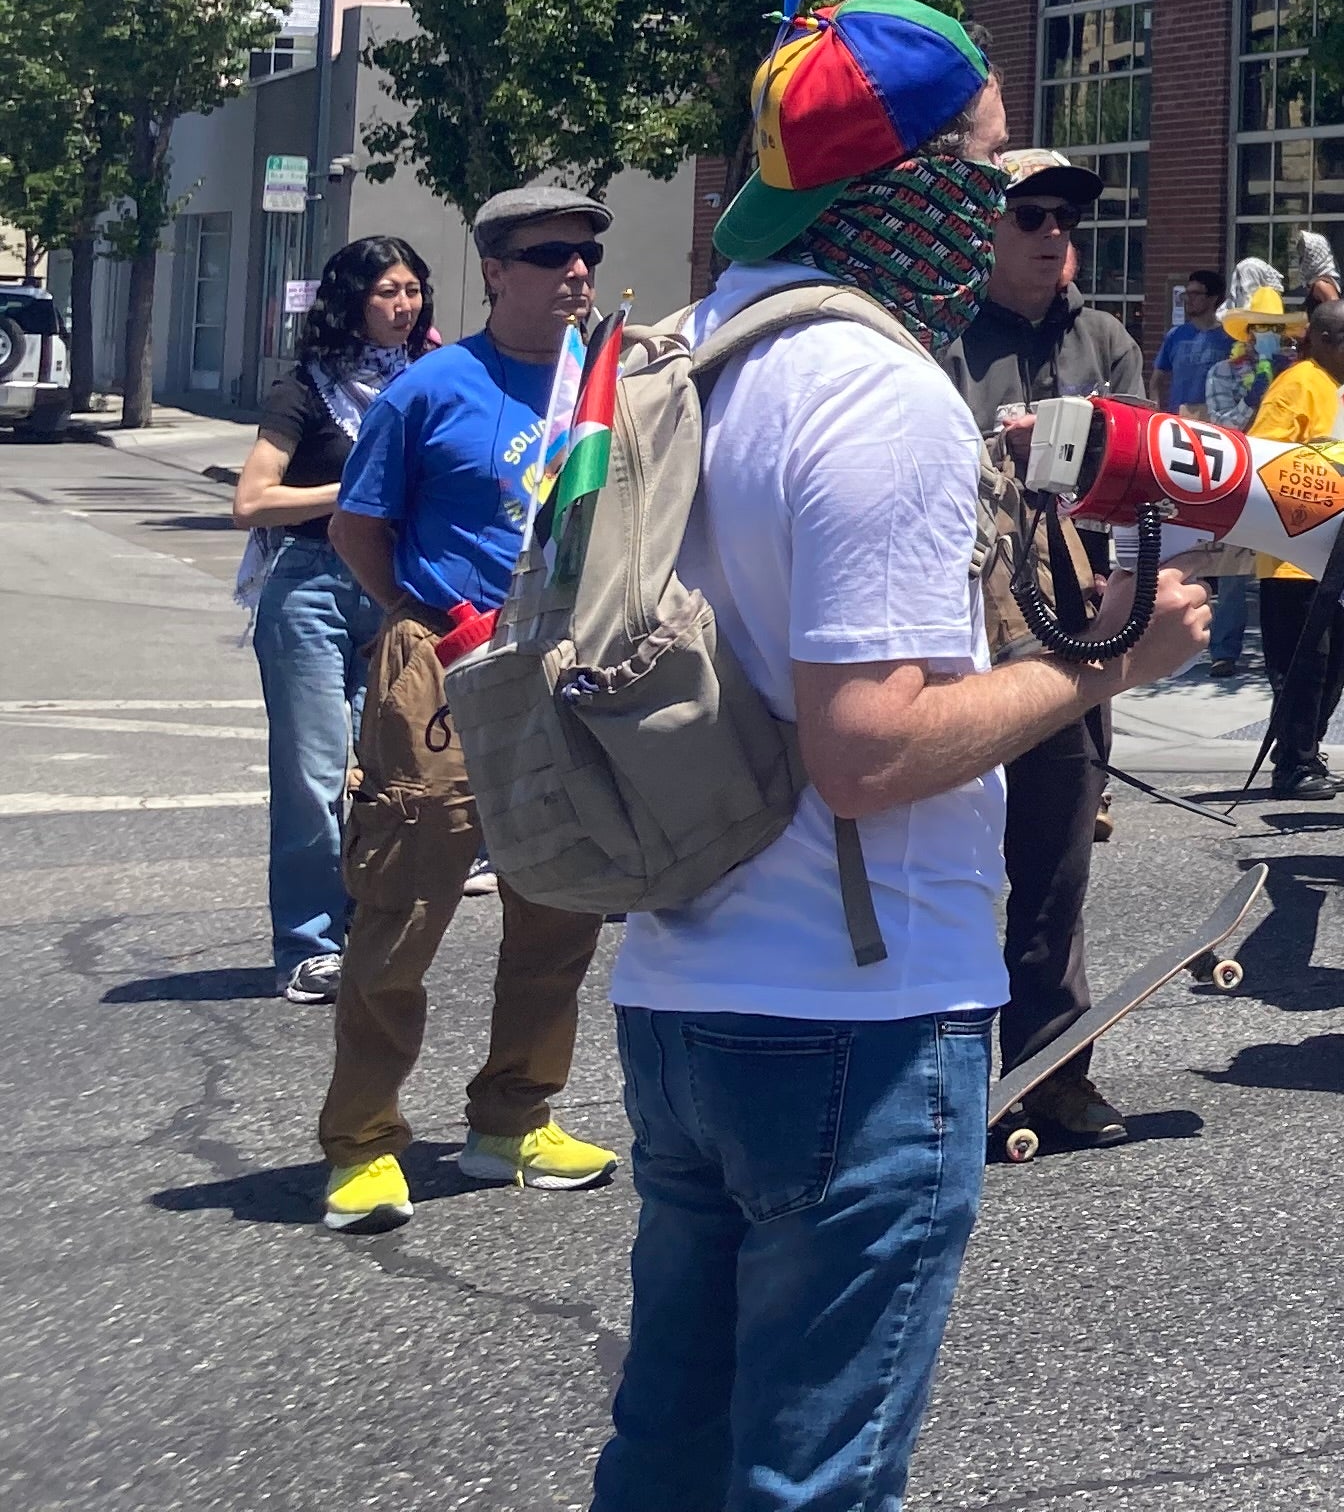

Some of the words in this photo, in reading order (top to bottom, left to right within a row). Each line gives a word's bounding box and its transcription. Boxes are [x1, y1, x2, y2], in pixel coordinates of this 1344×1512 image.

[923, 204, 947, 225] THE
[880, 213, 906, 234] THE
[931, 240, 951, 260] THE
[890, 248, 916, 271] THE
[1293, 461, 1327, 477] END
[1279, 469, 1340, 494] FOSSIL
